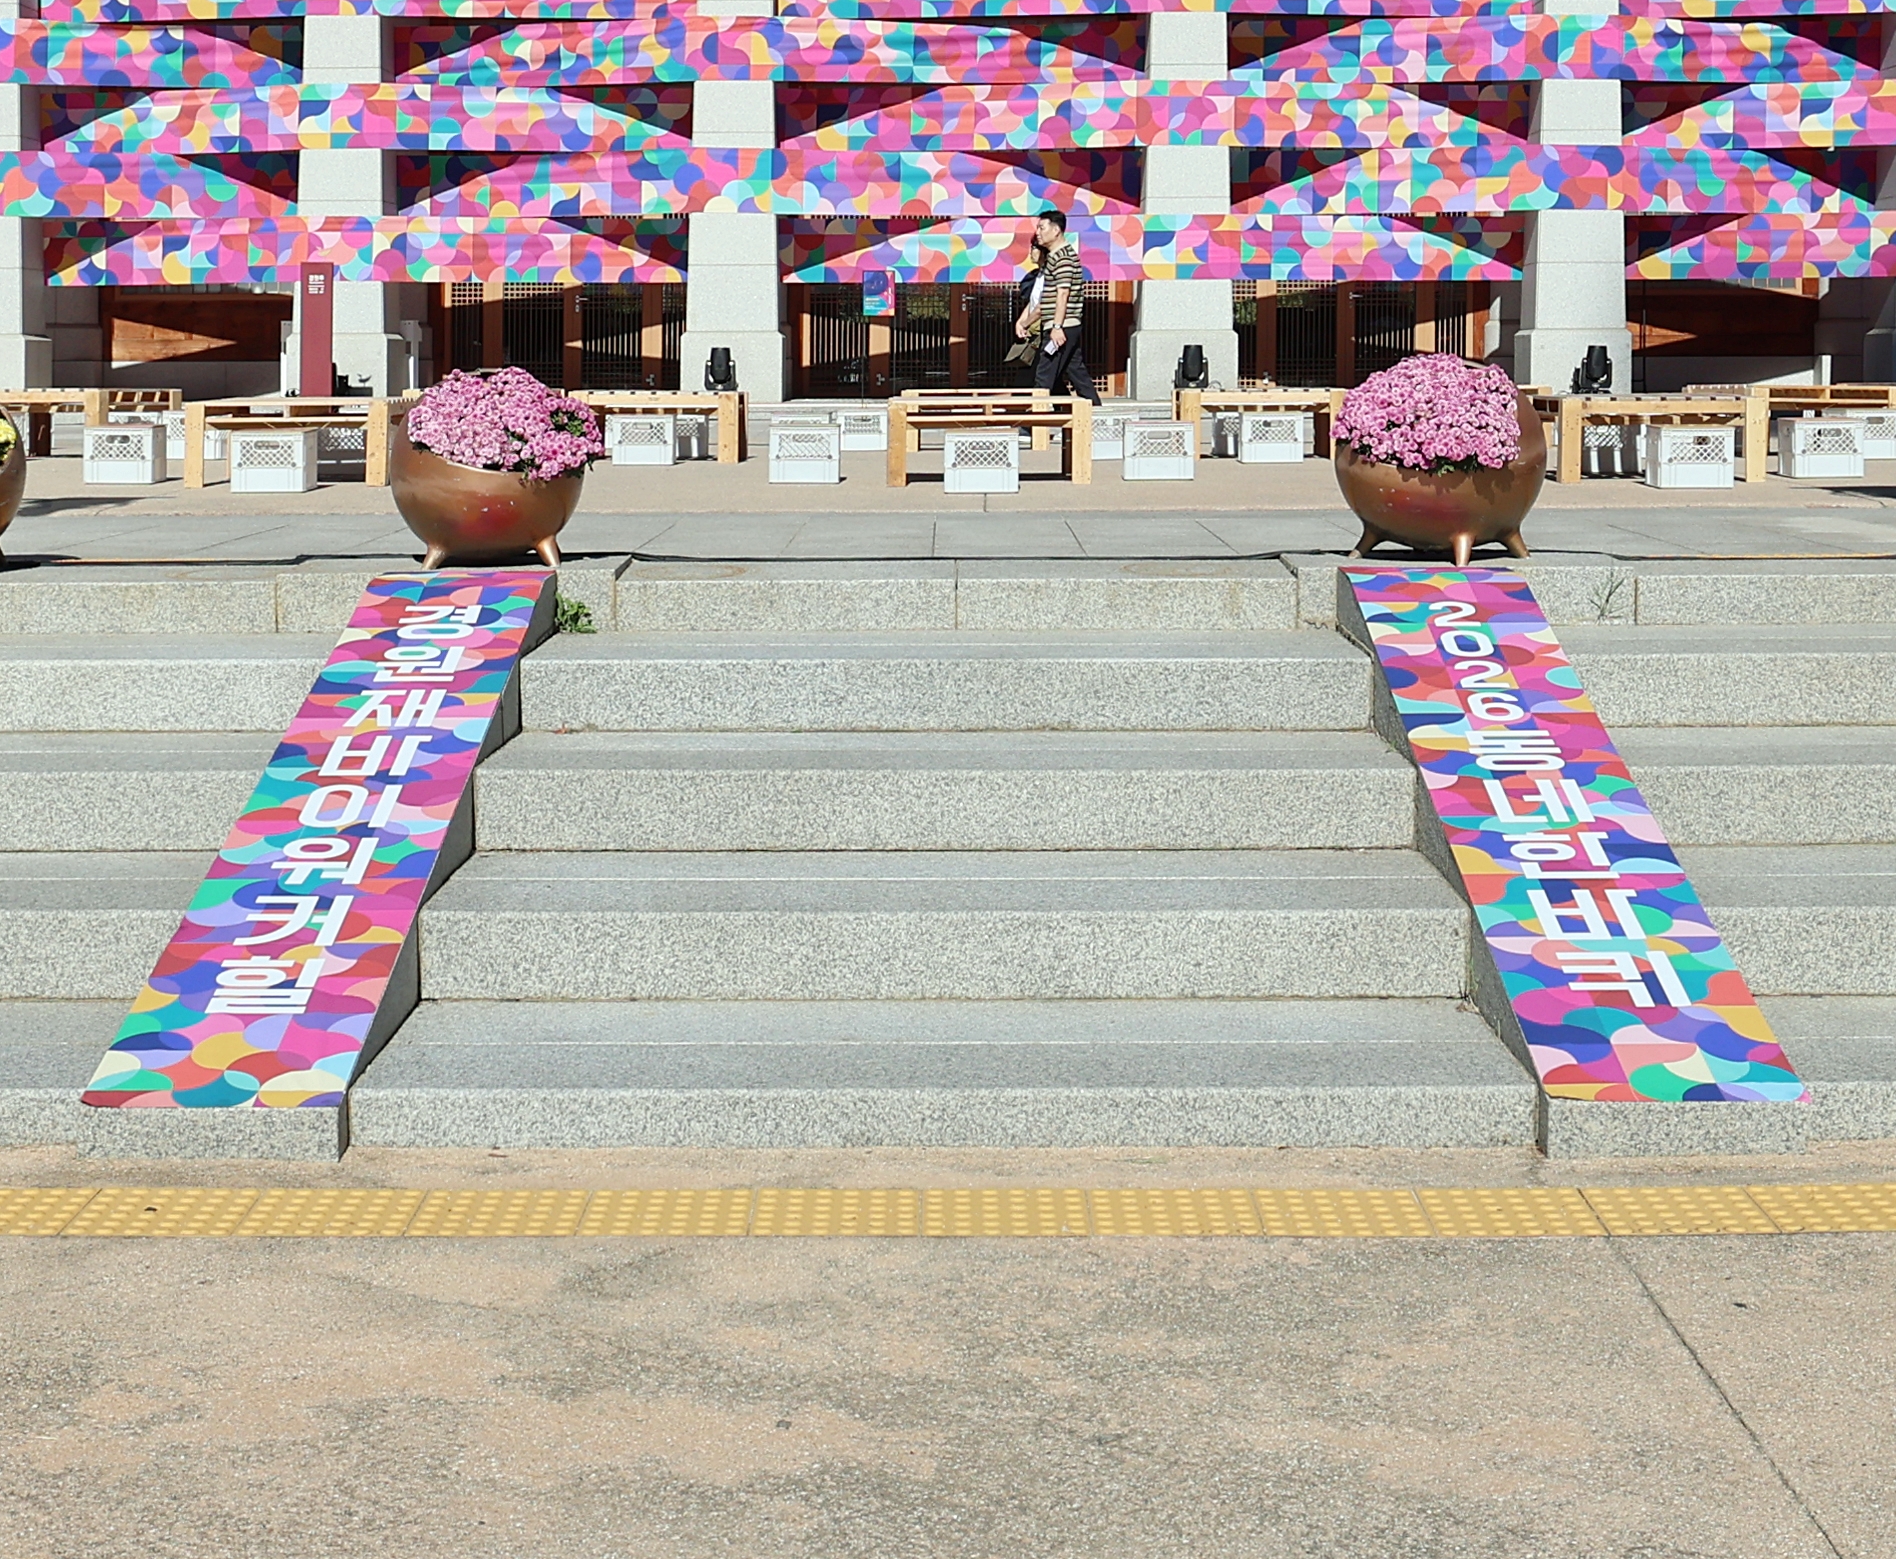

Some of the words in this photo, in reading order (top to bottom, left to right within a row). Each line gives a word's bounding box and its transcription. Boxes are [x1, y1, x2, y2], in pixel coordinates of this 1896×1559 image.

[1427, 600, 1526, 723] 2026
[204, 605, 484, 1015] 경원재바이워커힐
[1468, 729, 1695, 1008] 동네한바퀴
